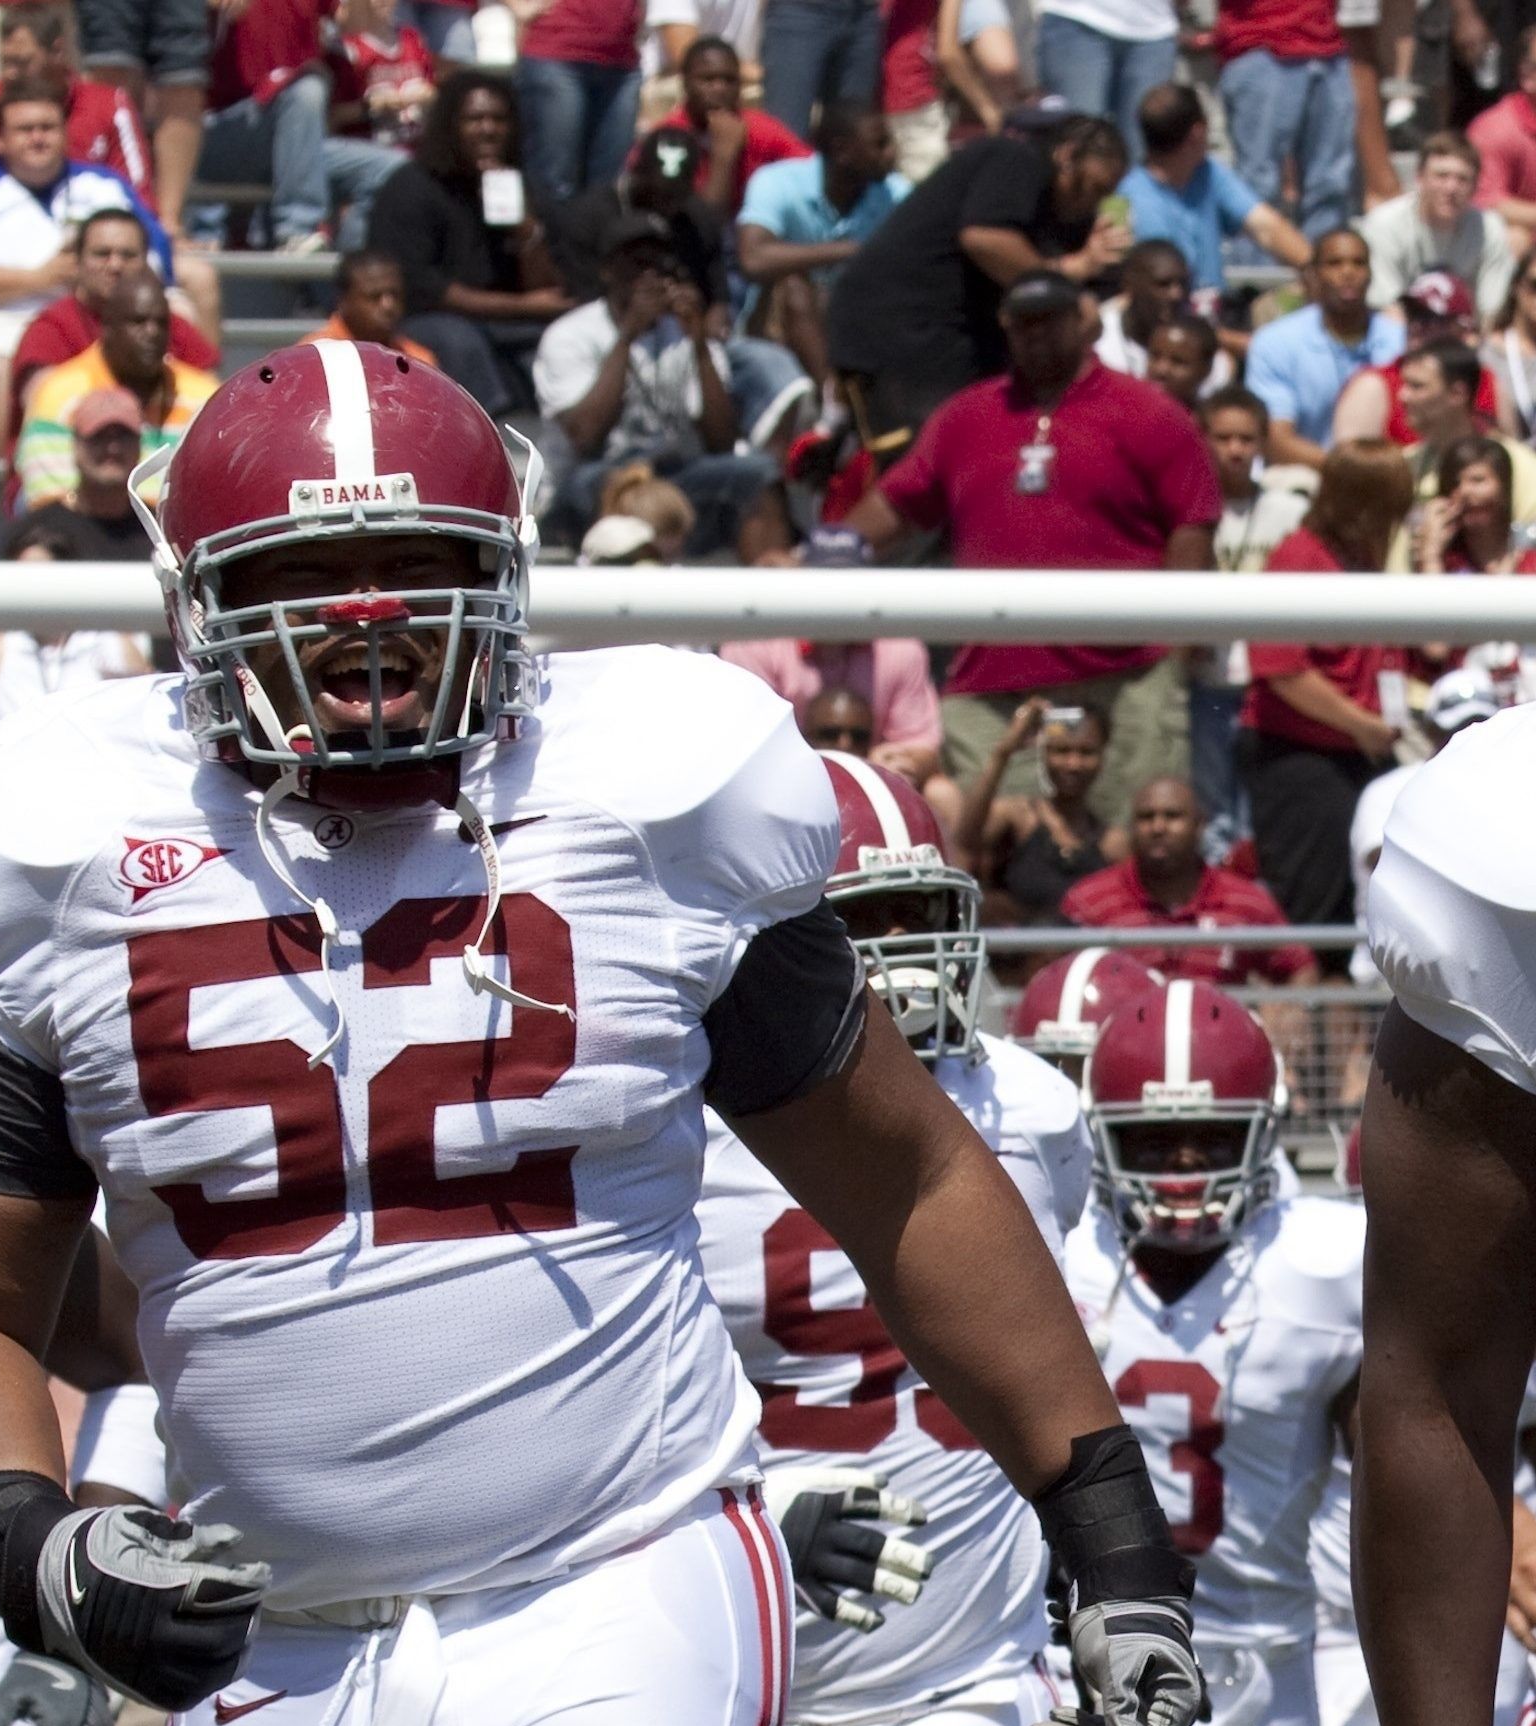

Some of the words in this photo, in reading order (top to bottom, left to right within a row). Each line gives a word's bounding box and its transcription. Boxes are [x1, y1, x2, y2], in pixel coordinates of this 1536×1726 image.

[322, 484, 386, 505] BAMA
[138, 843, 183, 883] SEC
[128, 892, 578, 1260] 52
